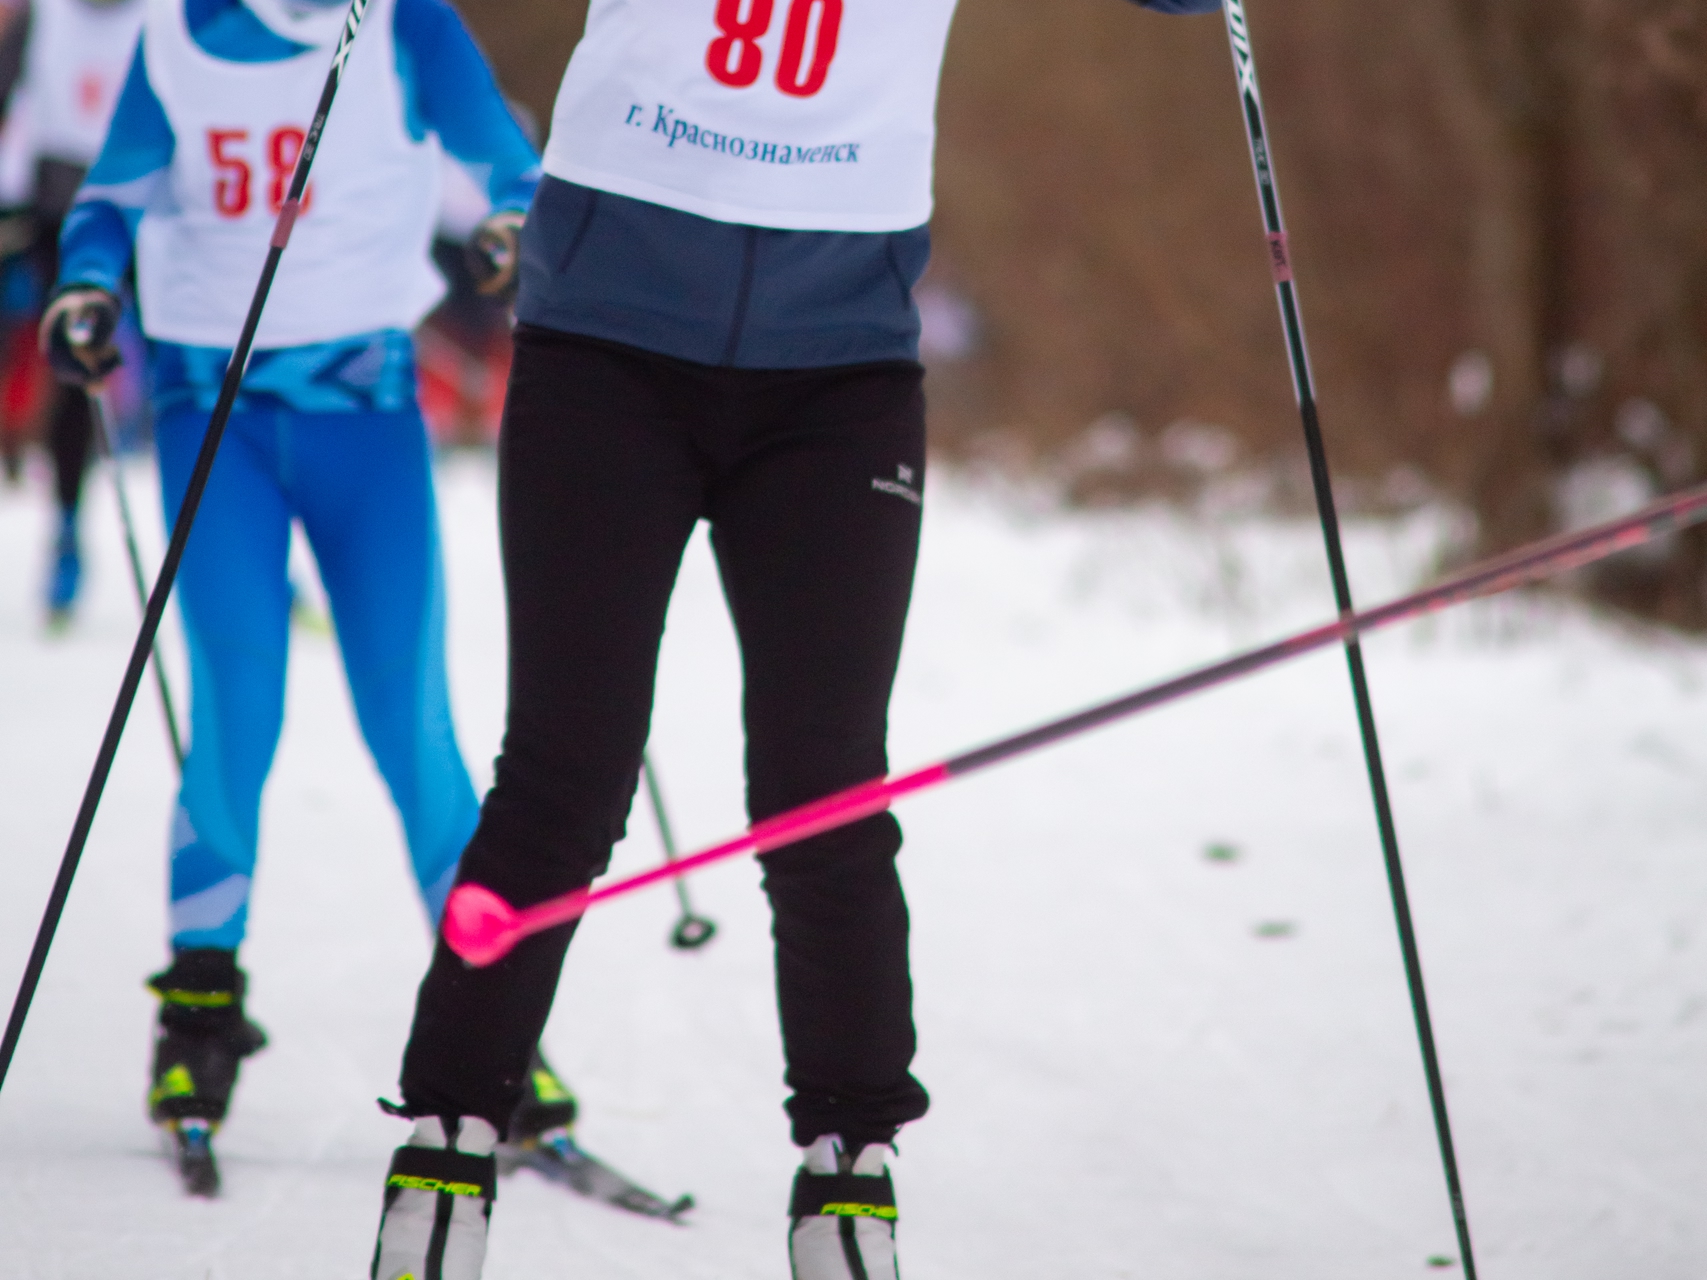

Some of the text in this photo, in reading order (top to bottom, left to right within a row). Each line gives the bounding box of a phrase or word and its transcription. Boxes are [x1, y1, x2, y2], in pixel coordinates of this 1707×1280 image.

[625, 103, 860, 165] г. Краснознаменск
[207, 127, 312, 217] 58
[386, 1173, 482, 1198] FISCHER
[820, 1202, 898, 1220] FISCHE
